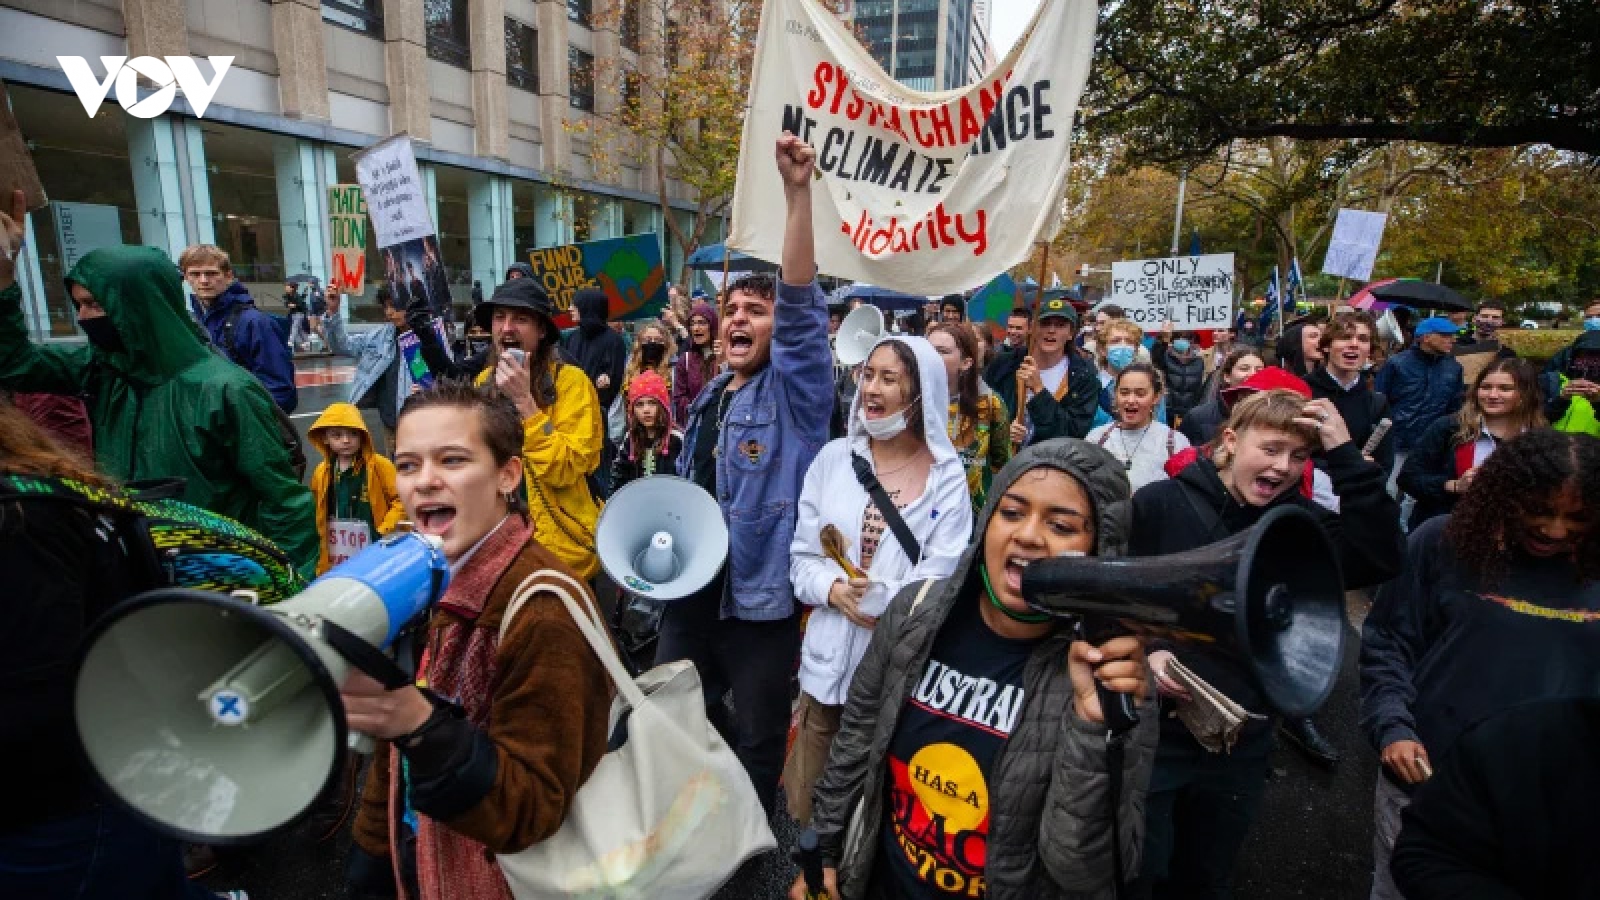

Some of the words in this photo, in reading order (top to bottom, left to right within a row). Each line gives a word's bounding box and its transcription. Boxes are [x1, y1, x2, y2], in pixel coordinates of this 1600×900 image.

[820, 127, 954, 193] CLIMATE
[329, 186, 367, 213] MATE
[329, 216, 365, 249] TION
[842, 202, 987, 257] lidarity
[530, 245, 582, 276] FUND
[1142, 258, 1200, 276] ONLY
[543, 266, 585, 291] OUR
[1114, 275, 1168, 294] FOSSIL
[1144, 290, 1211, 304] SUPPORT
[1186, 304, 1229, 324] FUELS
[329, 528, 367, 550] STOP
[914, 765, 959, 798] HAS
[965, 790, 981, 810] A
